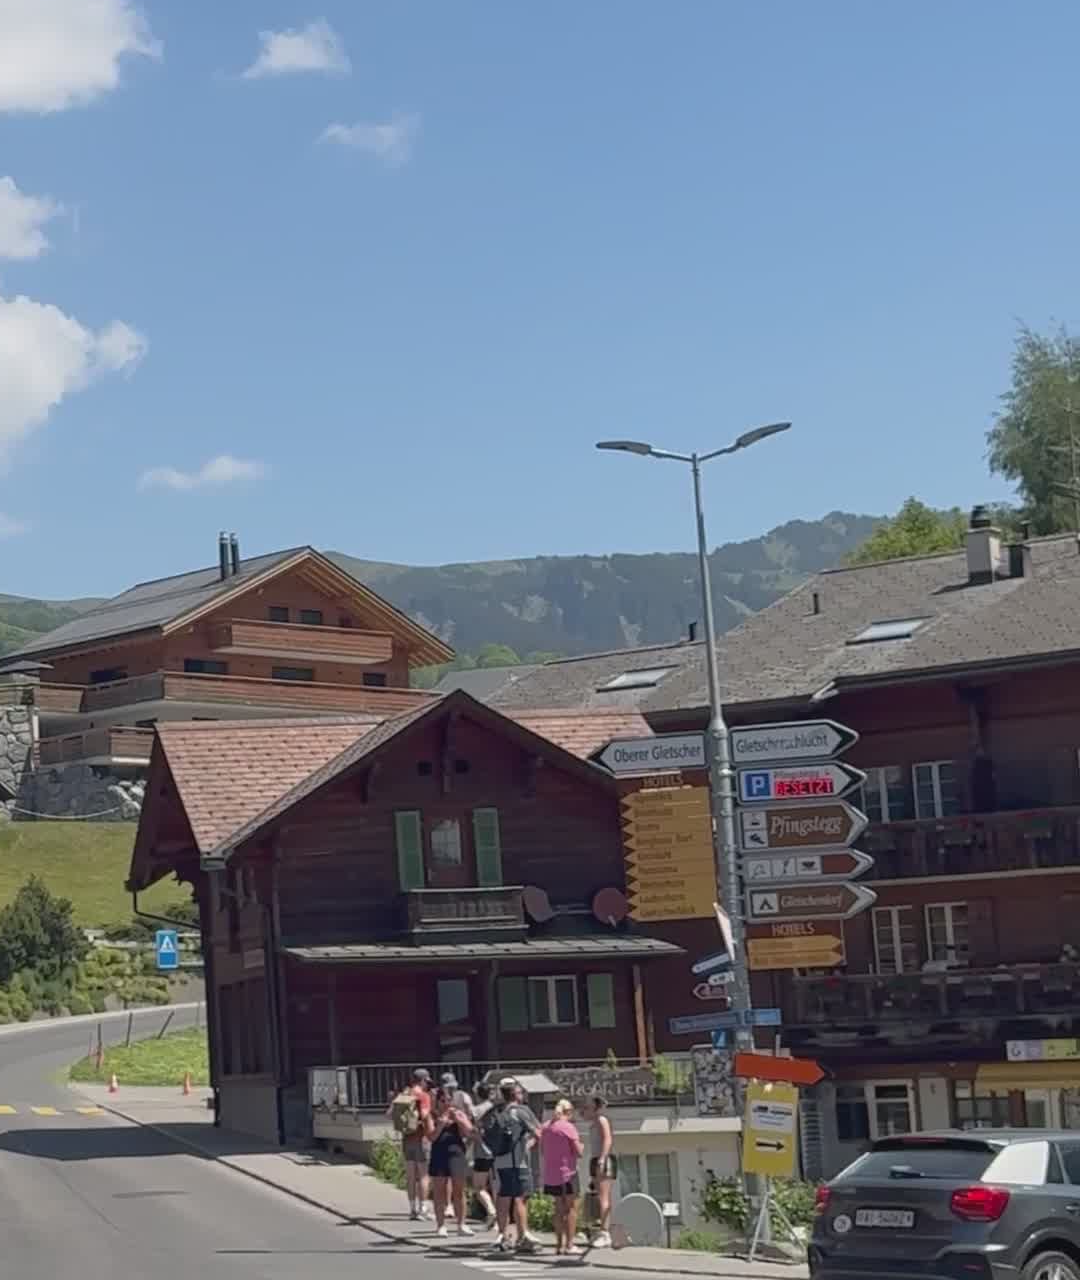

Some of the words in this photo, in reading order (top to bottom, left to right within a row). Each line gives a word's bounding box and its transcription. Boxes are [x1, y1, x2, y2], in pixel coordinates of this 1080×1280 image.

[613, 748, 649, 763] Oberer
[651, 743, 701, 760] Gletscher
[770, 814, 843, 838] Pfingstegg
[771, 922, 816, 937] HOTELS
